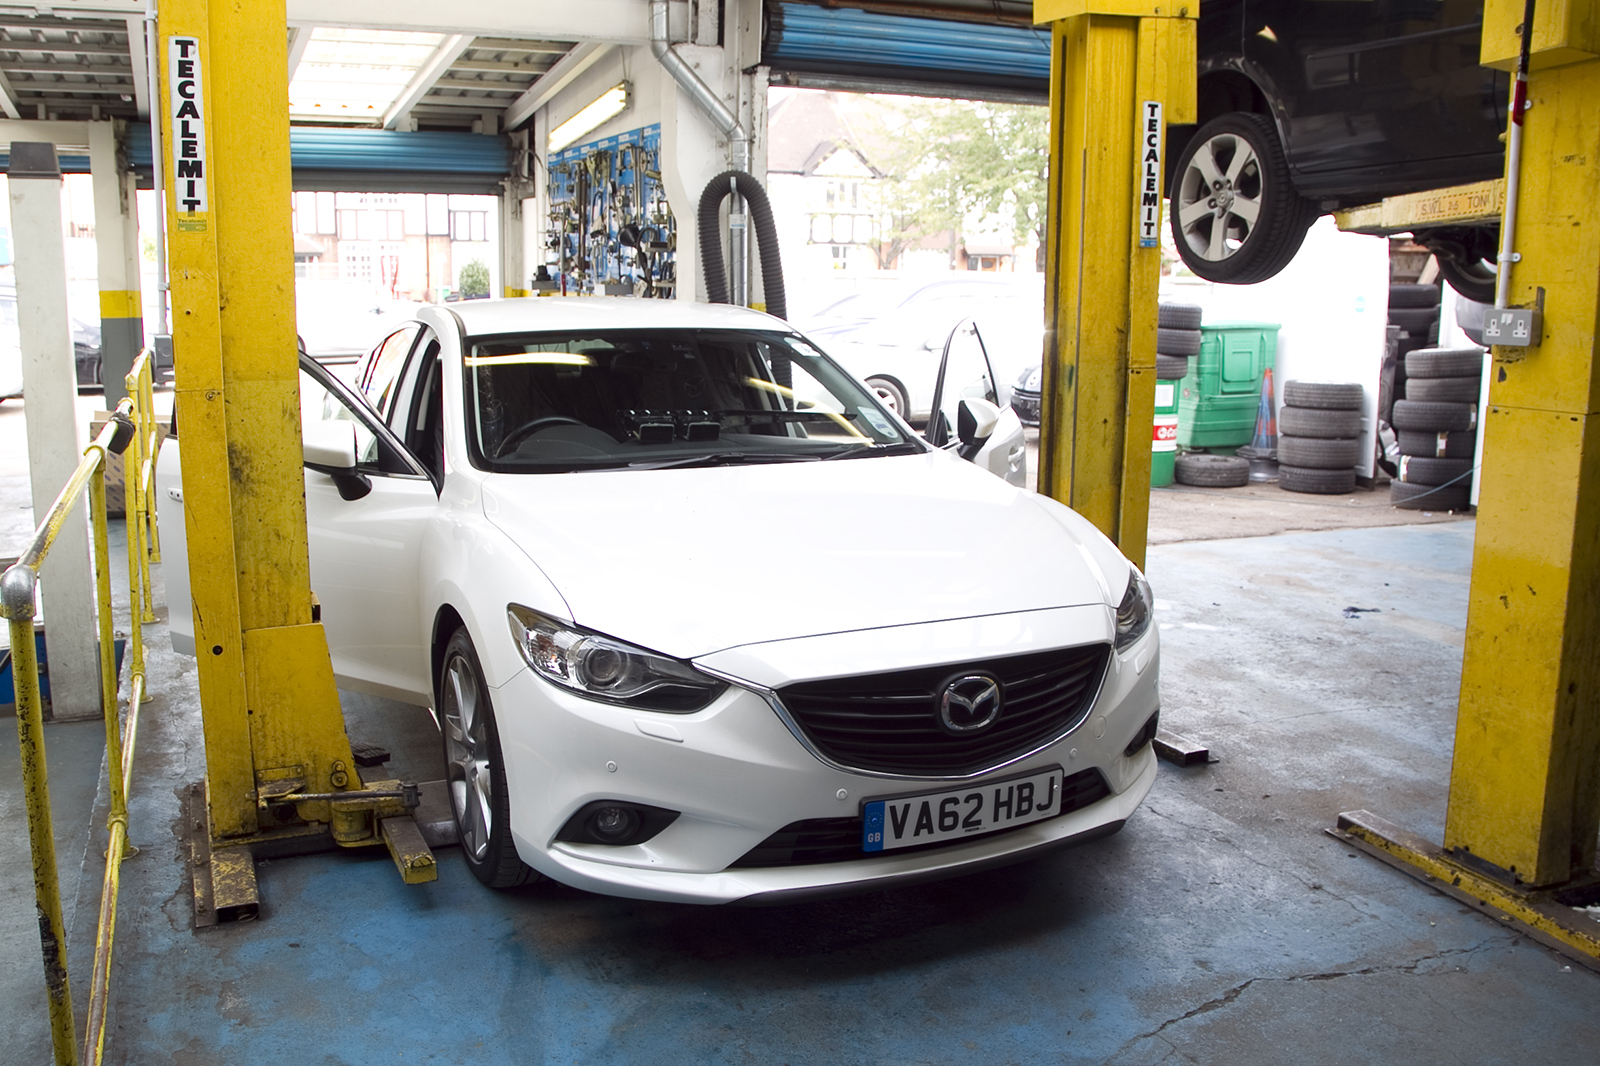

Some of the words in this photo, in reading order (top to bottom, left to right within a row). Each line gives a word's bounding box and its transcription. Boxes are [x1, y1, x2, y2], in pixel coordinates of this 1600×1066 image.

[175, 40, 203, 217] TECALEMIT
[1143, 104, 1159, 236] TECALEMIT
[867, 832, 881, 843] GB
[889, 792, 983, 839] VA62
[993, 776, 1055, 822] HBJ
